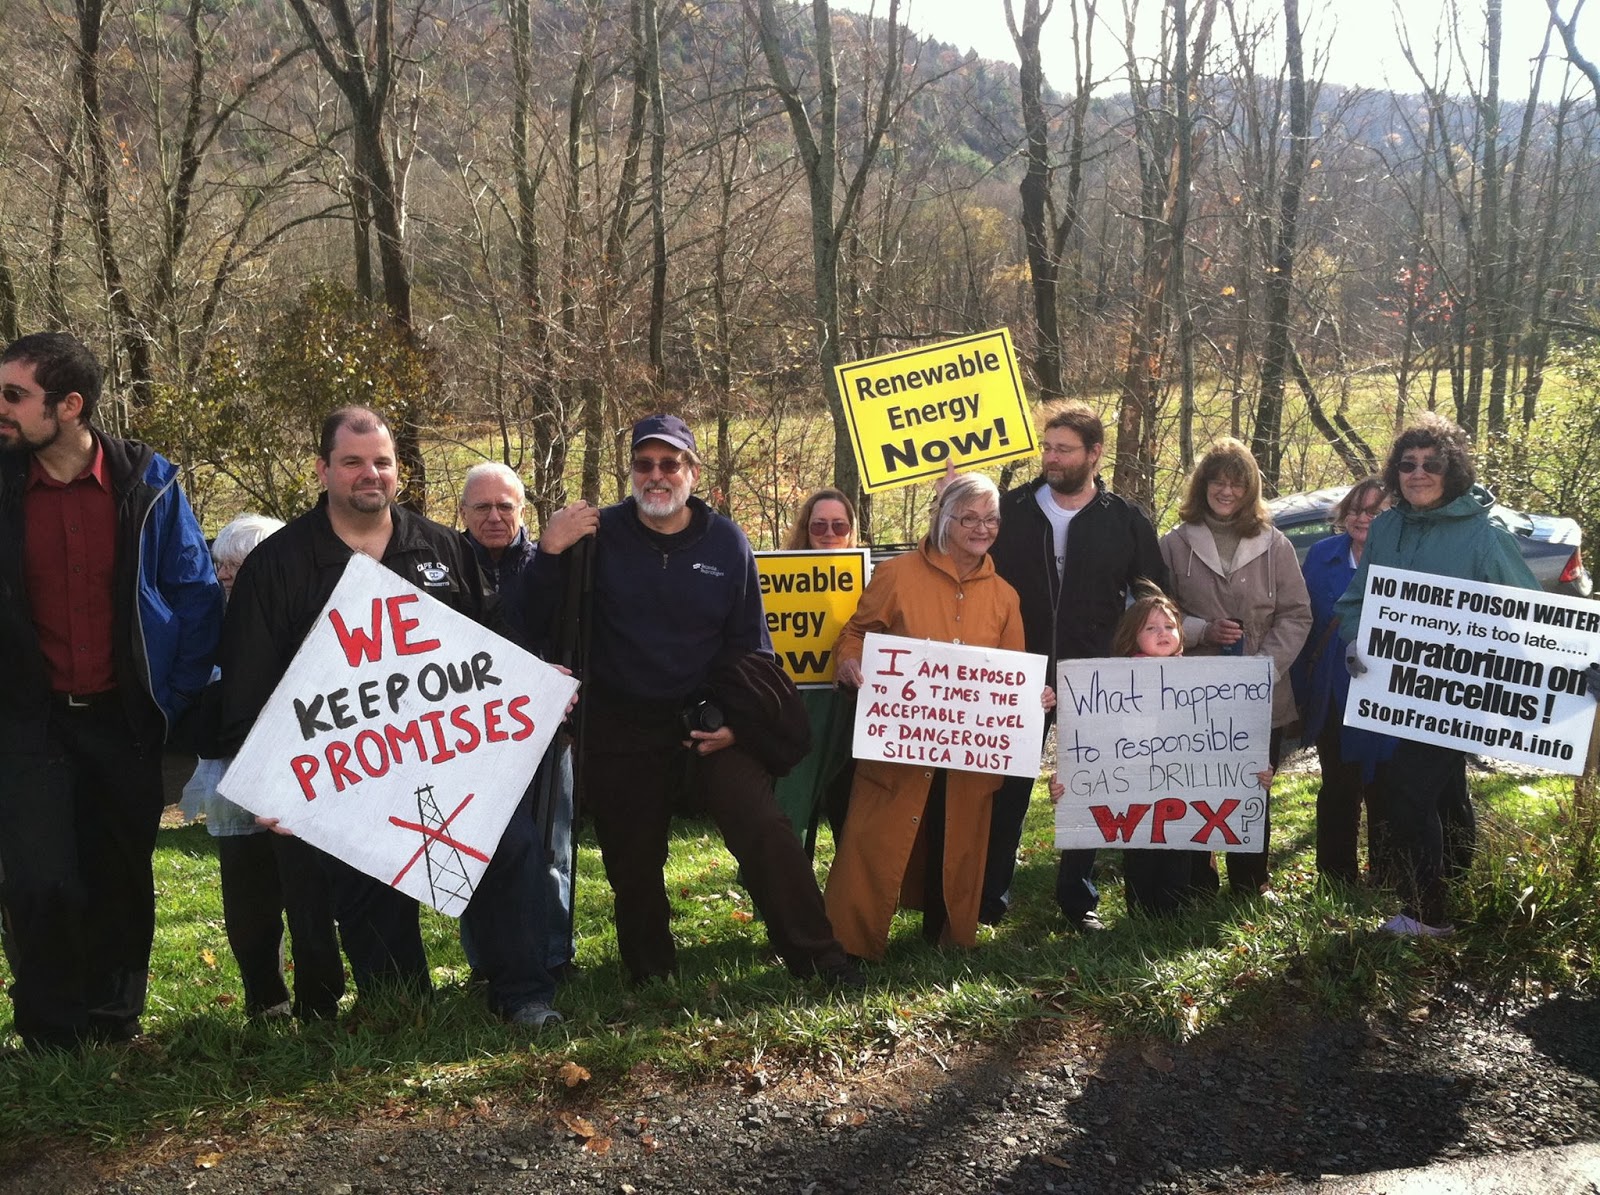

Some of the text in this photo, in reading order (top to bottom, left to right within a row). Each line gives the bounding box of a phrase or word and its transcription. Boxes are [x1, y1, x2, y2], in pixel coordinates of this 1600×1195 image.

[855, 350, 1000, 401] Renewable
[887, 393, 980, 431] Energy
[881, 417, 1010, 473] Now!
[759, 566, 853, 594] ewable
[1370, 576, 1600, 633] NO MORE POISON WATER
[329, 593, 441, 667] WE
[765, 611, 826, 638] ergy
[1378, 606, 1408, 623] For
[1411, 615, 1461, 636] many,
[1466, 621, 1487, 638] its
[1492, 626, 1520, 644] too
[876, 648, 1026, 686] I AM EXPOSED
[1367, 627, 1587, 697] Moratorium on
[293, 651, 502, 741] KEEP OUR
[866, 702, 1024, 729] ACCEPTABLE LEVEL
[871, 680, 1018, 706] TO 6 TIMES THE
[1063, 662, 1272, 724] What happened
[1388, 664, 1539, 722] Marcellus
[290, 695, 535, 801] PROMISES
[867, 723, 1011, 751] OF DANGEROUS
[1067, 717, 1249, 770] to responsible
[1358, 698, 1574, 761] StopFrackingPA.info
[882, 741, 1013, 770] SILICA DUST
[1070, 761, 1261, 797] GAS DRILLING
[1088, 797, 1264, 845] WPX?
